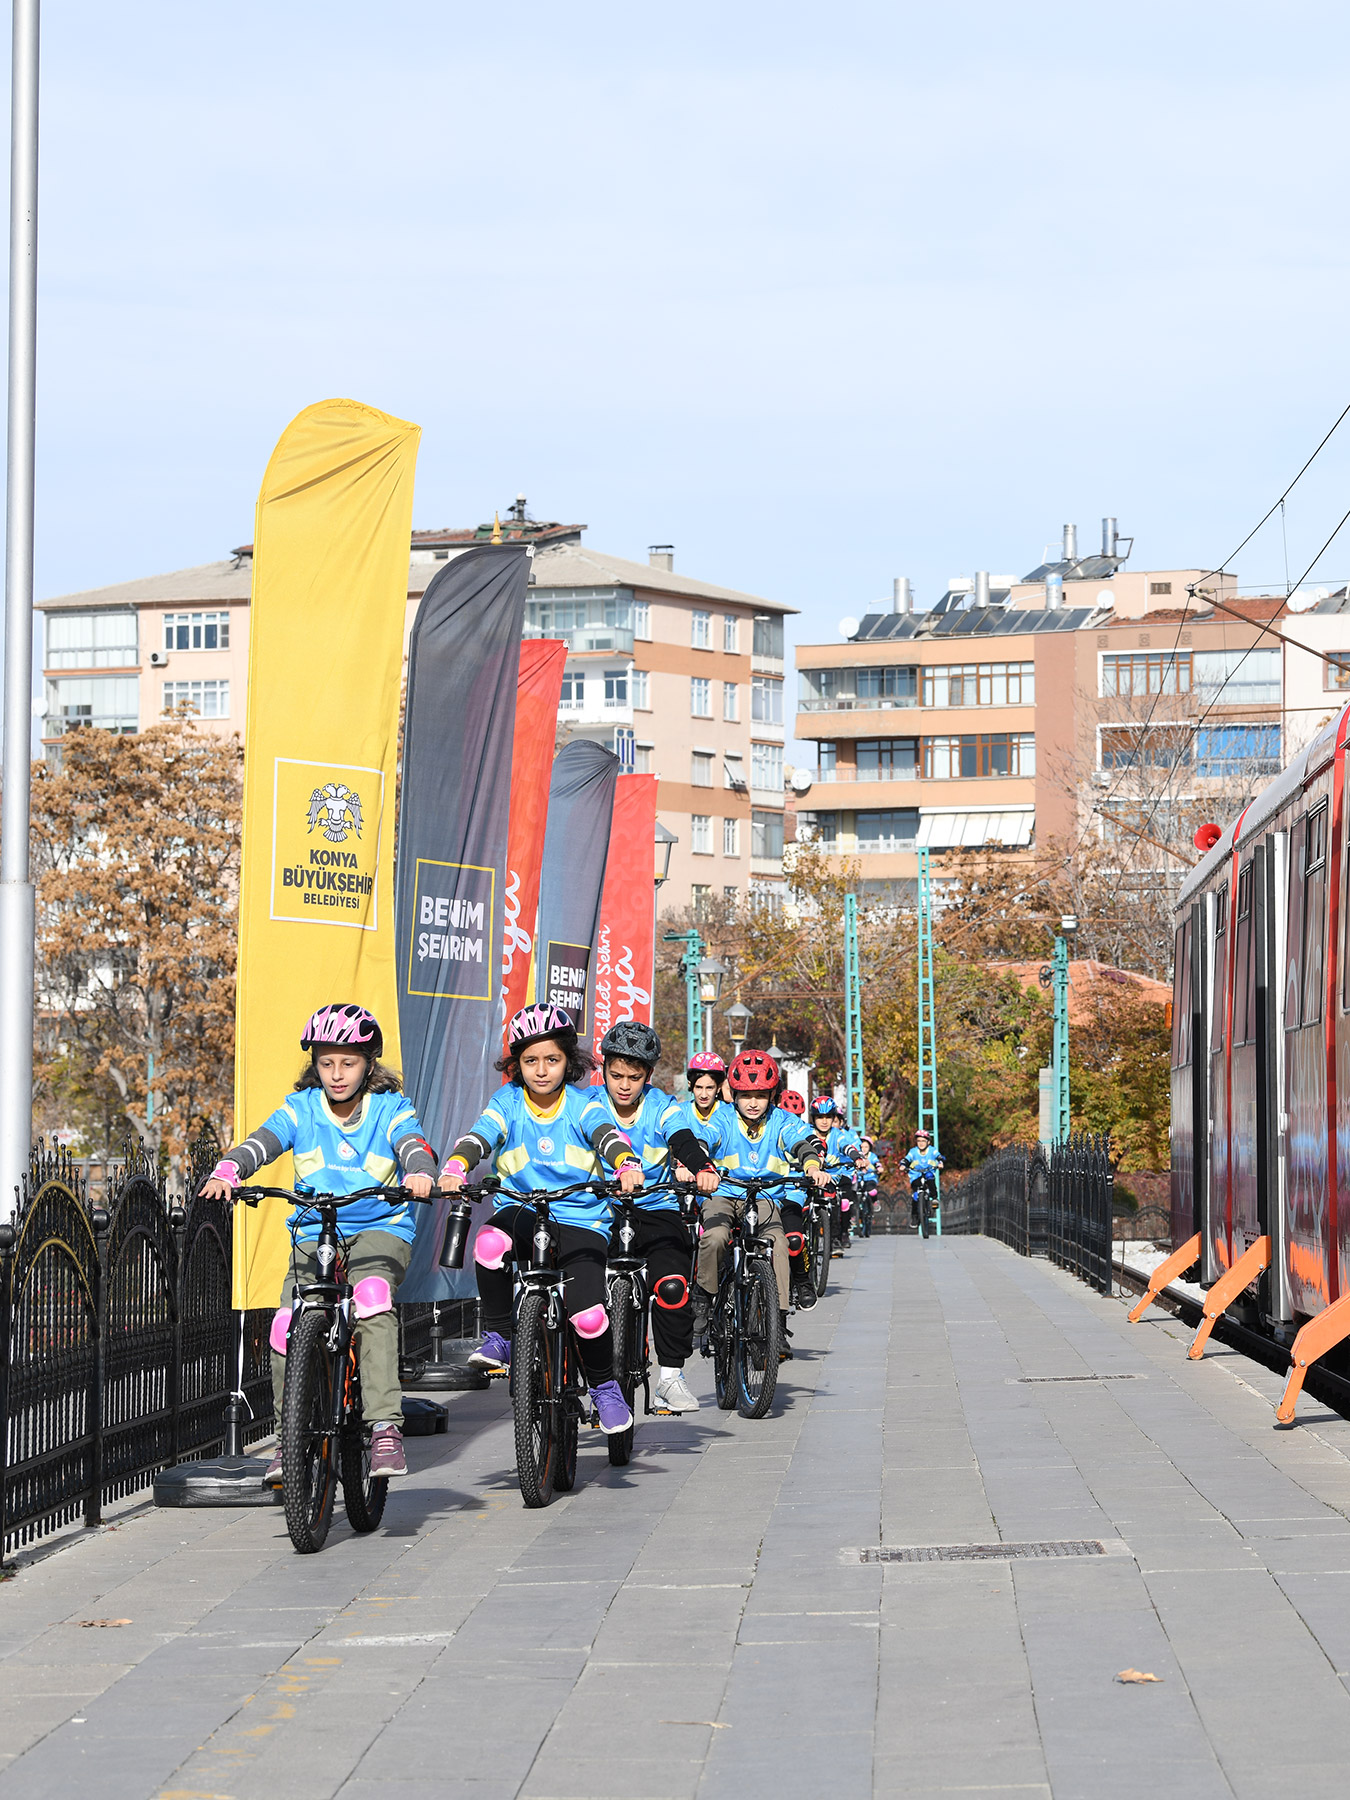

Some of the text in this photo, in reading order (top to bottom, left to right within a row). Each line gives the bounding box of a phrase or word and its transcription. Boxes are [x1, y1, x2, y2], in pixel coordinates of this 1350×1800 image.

[309, 848, 358, 869] KONYA
[282, 864, 373, 896] BÜYÜKŞEHİR
[303, 892, 360, 909] BELEDİYESİ
